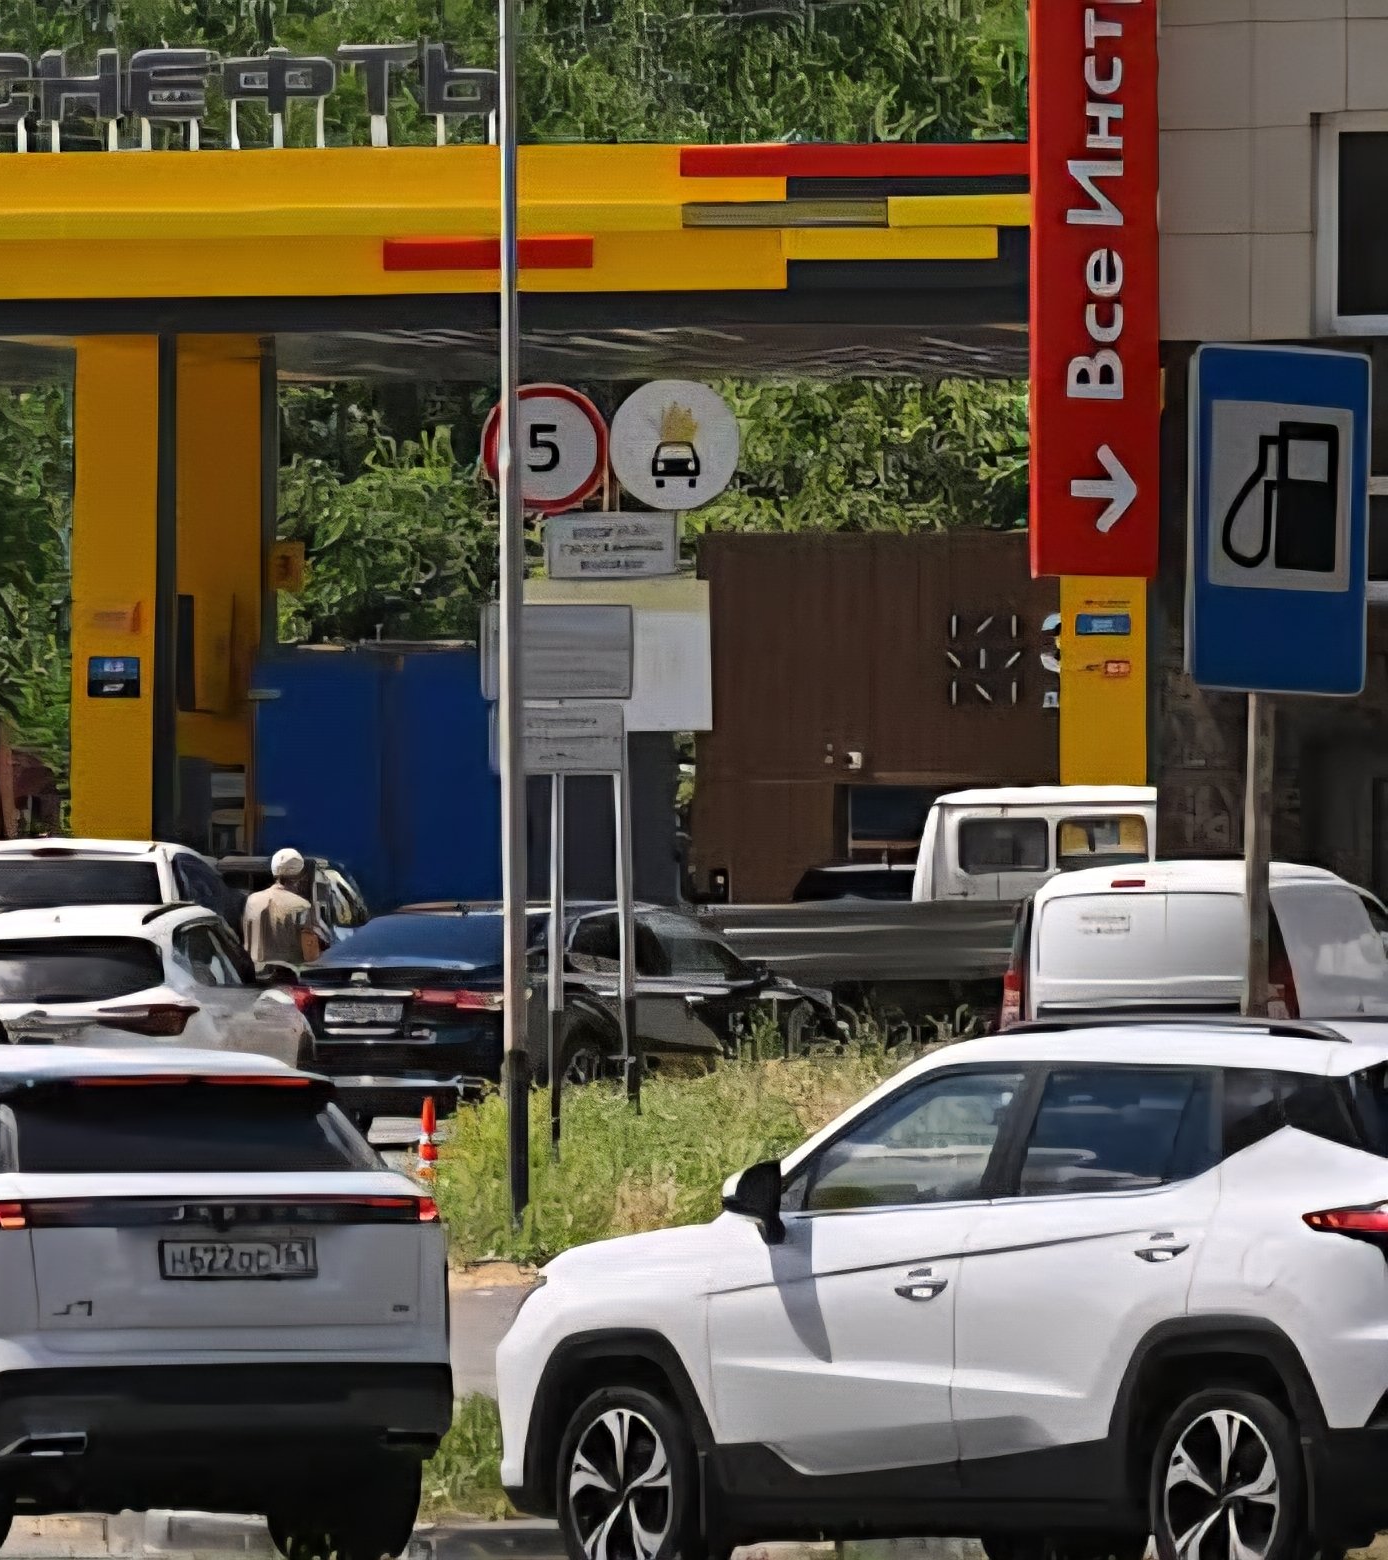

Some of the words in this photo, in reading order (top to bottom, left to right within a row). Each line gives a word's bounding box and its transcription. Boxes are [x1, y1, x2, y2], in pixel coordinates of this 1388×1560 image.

[1066, 0, 1143, 226] Инст
[1066, 248, 1124, 400] Все
[527, 423, 560, 472] 5
